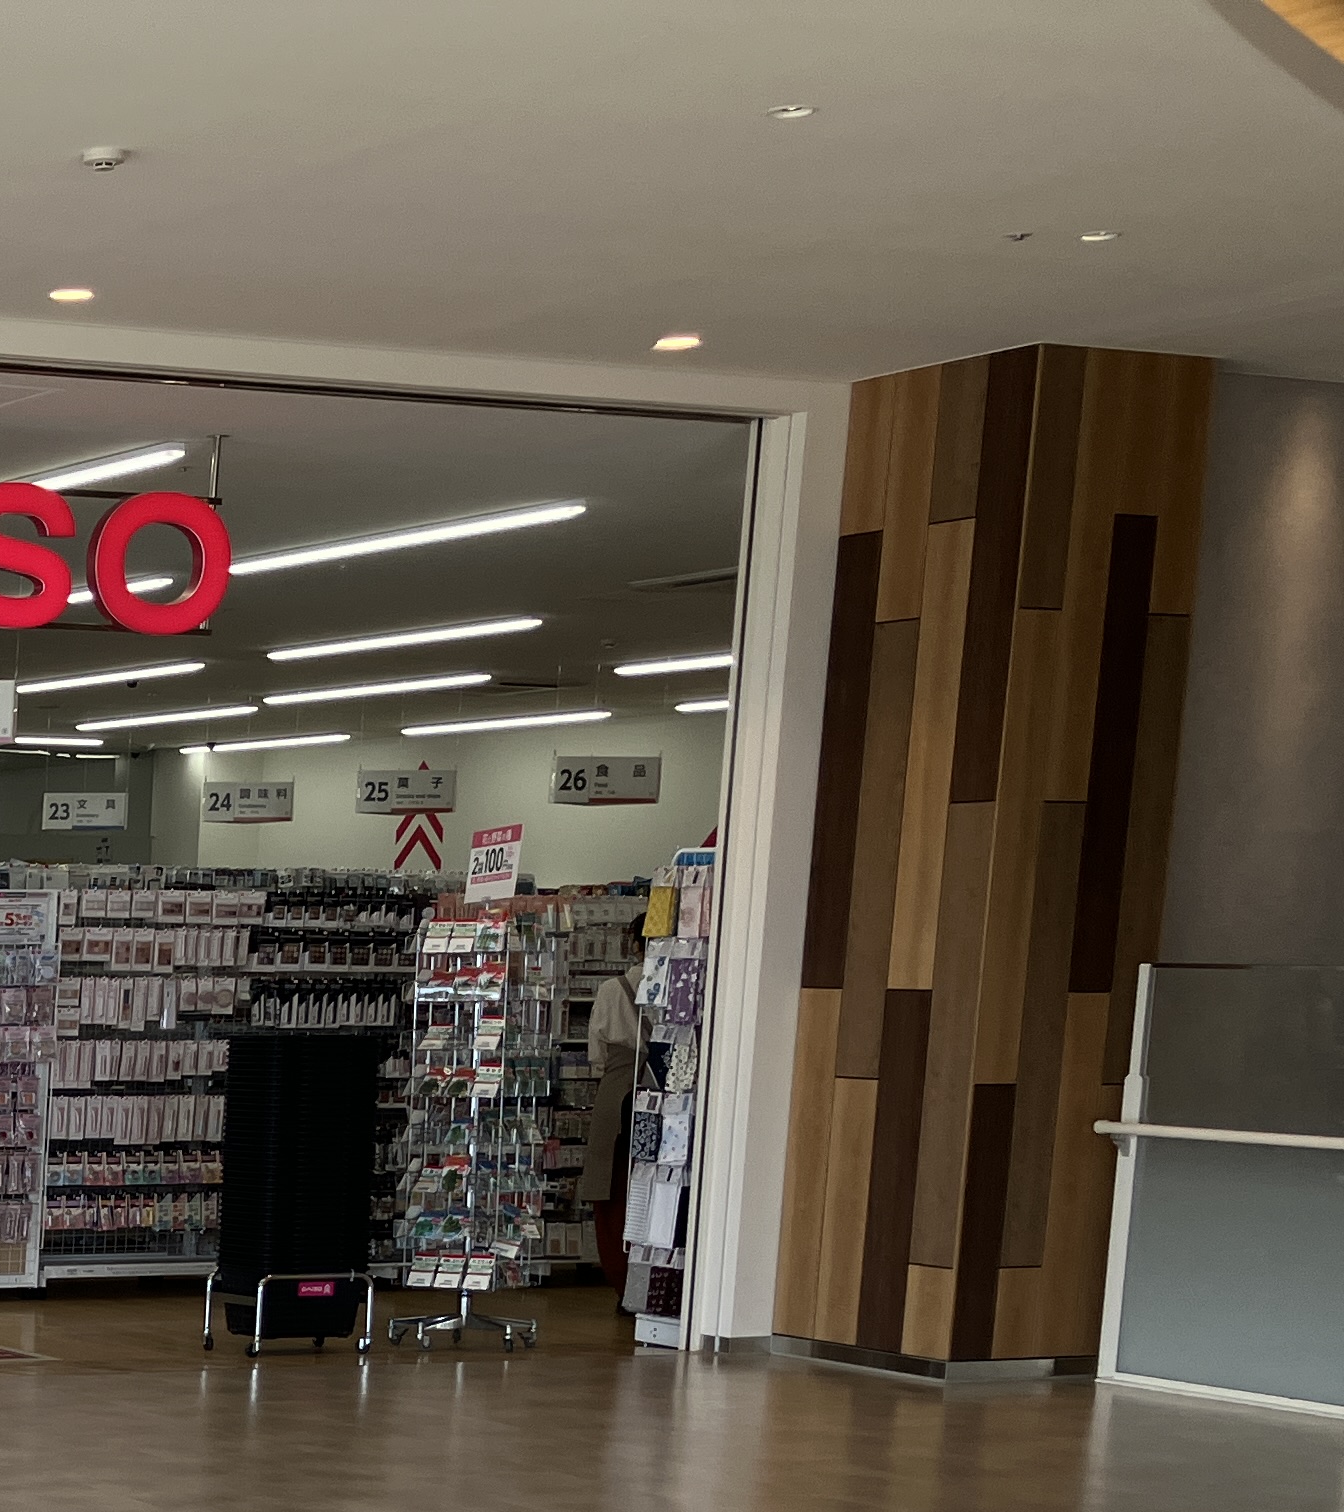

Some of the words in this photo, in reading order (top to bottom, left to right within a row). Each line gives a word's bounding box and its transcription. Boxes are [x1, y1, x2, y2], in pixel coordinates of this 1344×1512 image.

[558, 769, 587, 791] 26
[363, 781, 389, 802] 25
[48, 802, 70, 821] 23
[208, 792, 232, 812] 24
